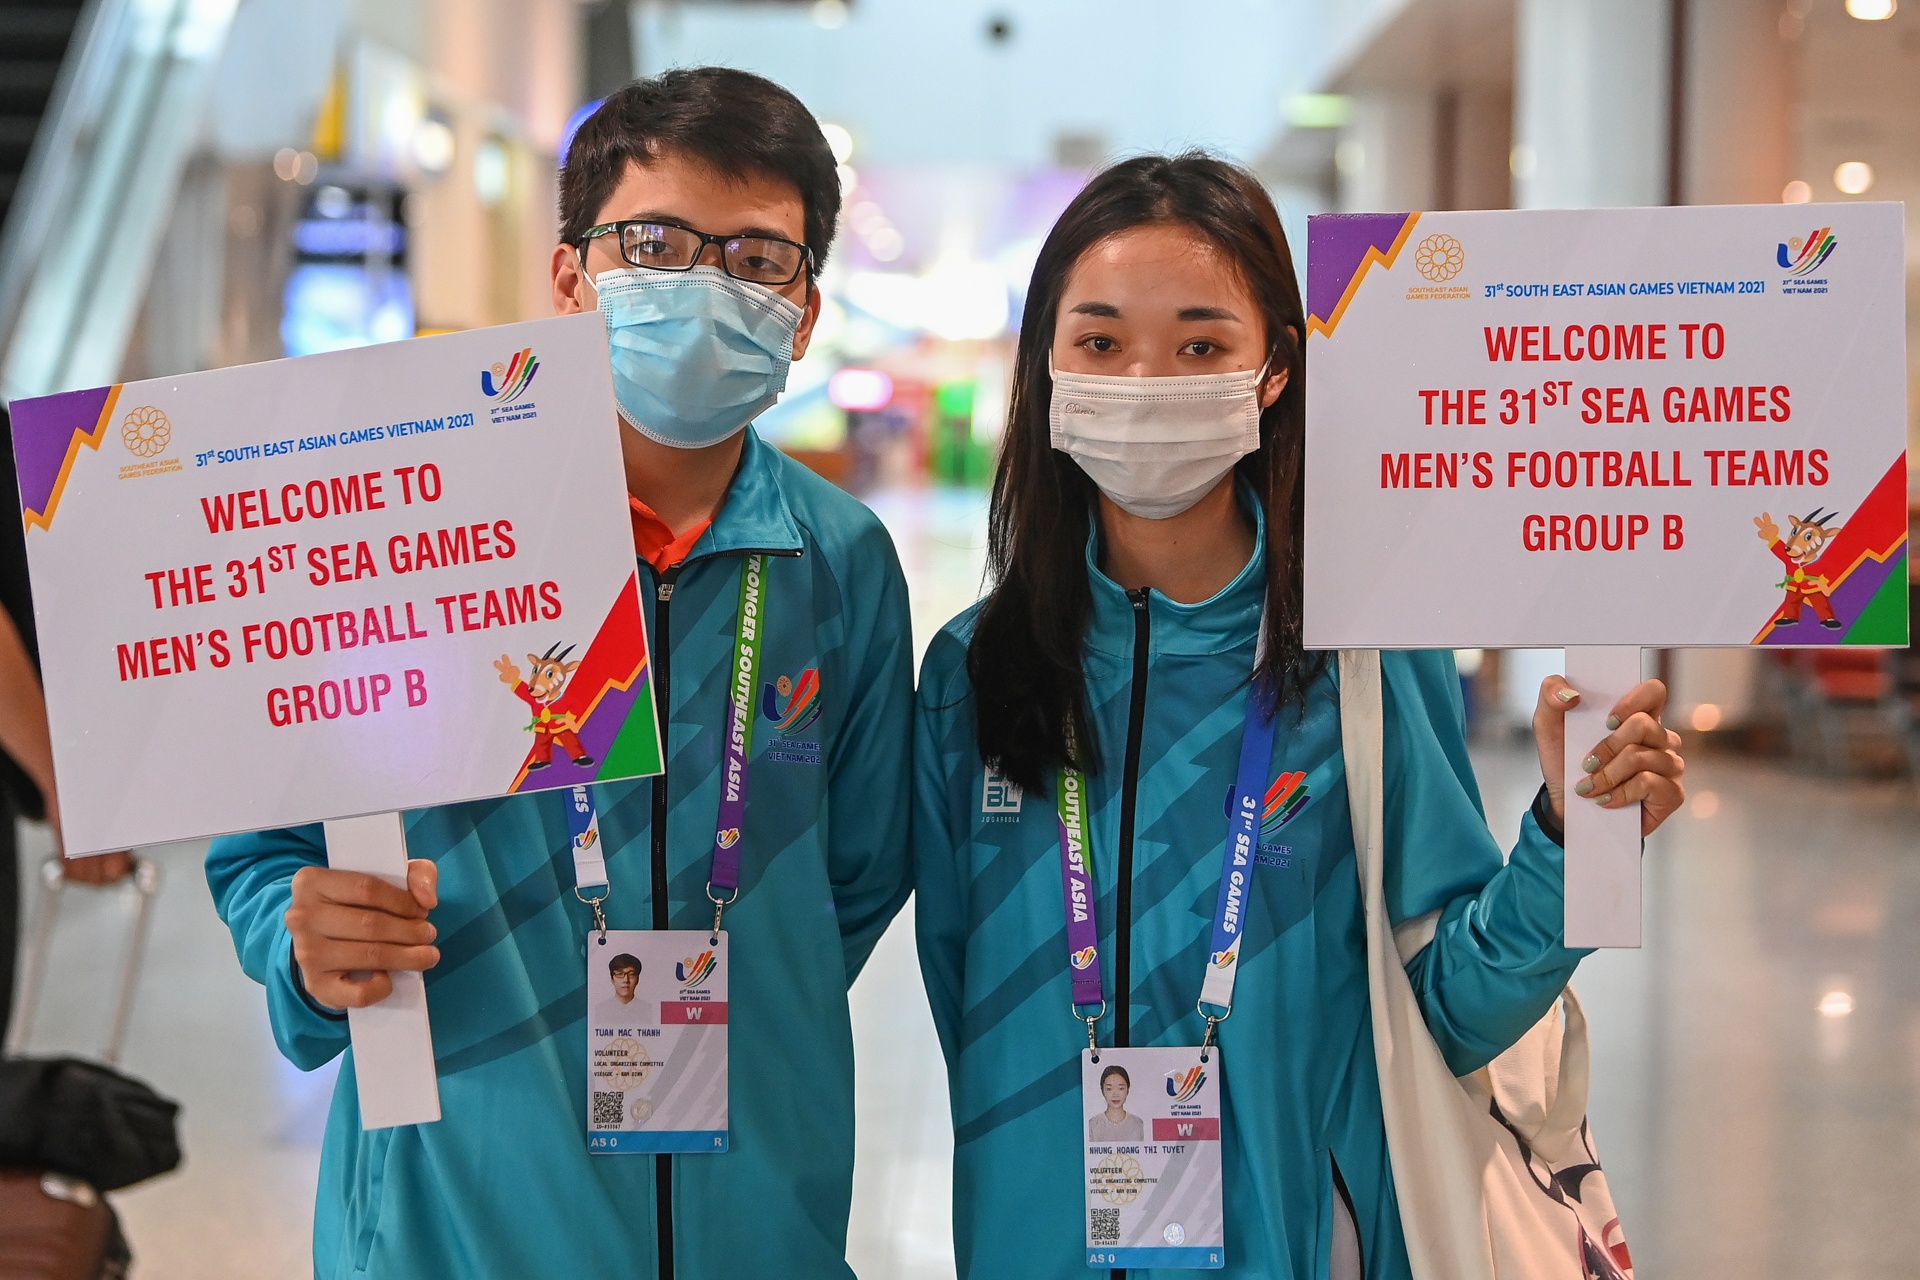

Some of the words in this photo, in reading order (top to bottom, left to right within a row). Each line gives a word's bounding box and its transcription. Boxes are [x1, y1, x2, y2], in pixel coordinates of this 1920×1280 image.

[1485, 283, 1504, 297] 31st
[1506, 284, 1549, 297] SOUTH
[1553, 284, 1584, 296] EAST
[1587, 283, 1626, 296] ASIAN
[1629, 282, 1674, 295] GAMES
[1677, 281, 1735, 294] VIETNAM
[1738, 280, 1765, 294] 2021
[1483, 323, 1667, 362] WELCOME
[1678, 323, 1726, 361] TO
[1418, 389, 1487, 426] THE
[1499, 380, 1574, 426] 31ST
[1581, 387, 1650, 424] SEA
[1662, 385, 1792, 423] GAMES
[195, 449, 215, 468] 31st
[217, 445, 260, 464] SOUTH
[264, 440, 295, 457] EAST
[298, 433, 337, 451] ASIAN
[340, 426, 384, 445] GAMES
[386, 417, 445, 437] VIETNAM
[447, 412, 475, 429] 2021
[118, 471, 141, 480] GAMES
[142, 465, 183, 476] FEDERATION
[119, 461, 159, 473] SOUTHEAST
[160, 458, 180, 466] ASIAN
[1380, 451, 1494, 489] MEN'S
[1507, 450, 1692, 488] FOOTBALL
[1703, 449, 1830, 487] TEAMS
[200, 472, 386, 535] WELCOME
[393, 463, 442, 505] TO
[1522, 514, 1650, 552] GROUP
[1663, 513, 1685, 551] B
[144, 563, 217, 610] THE
[225, 543, 298, 599] 31ST
[307, 540, 379, 587] SEA
[387, 519, 517, 575] GAMES
[742, 555, 762, 641] TRONGER
[116, 628, 232, 682] MEN'S
[242, 601, 429, 664] FOOTBALL
[435, 580, 563, 635] TEAMS
[266, 673, 392, 728] GROUP
[404, 668, 428, 708] B
[731, 643, 753, 757] SOUTHEAST
[786, 754, 803, 762] NAM
[726, 757, 742, 802] ASIA
[1064, 766, 1085, 875] SOUTHEAST
[1240, 796, 1256, 831] 31st
[1233, 833, 1250, 866] SEA
[1254, 855, 1268, 864] AM
[1270, 858, 1290, 867] 2021
[1262, 844, 1292, 854] GAMES
[1070, 877, 1088, 923] ASIA
[1223, 871, 1244, 934] GAMES
[686, 1007, 702, 1020] W
[595, 1029, 614, 1037] TUAN
[618, 1029, 632, 1037] MAC
[637, 1029, 661, 1037] THANH
[591, 1137, 607, 1147] AS
[714, 1137, 722, 1146] R
[1177, 1123, 1193, 1137] W
[1117, 1146, 1140, 1154] HOANG
[1144, 1146, 1157, 1154] THI
[1089, 1254, 1105, 1263] AS
[1210, 1253, 1218, 1262] R
